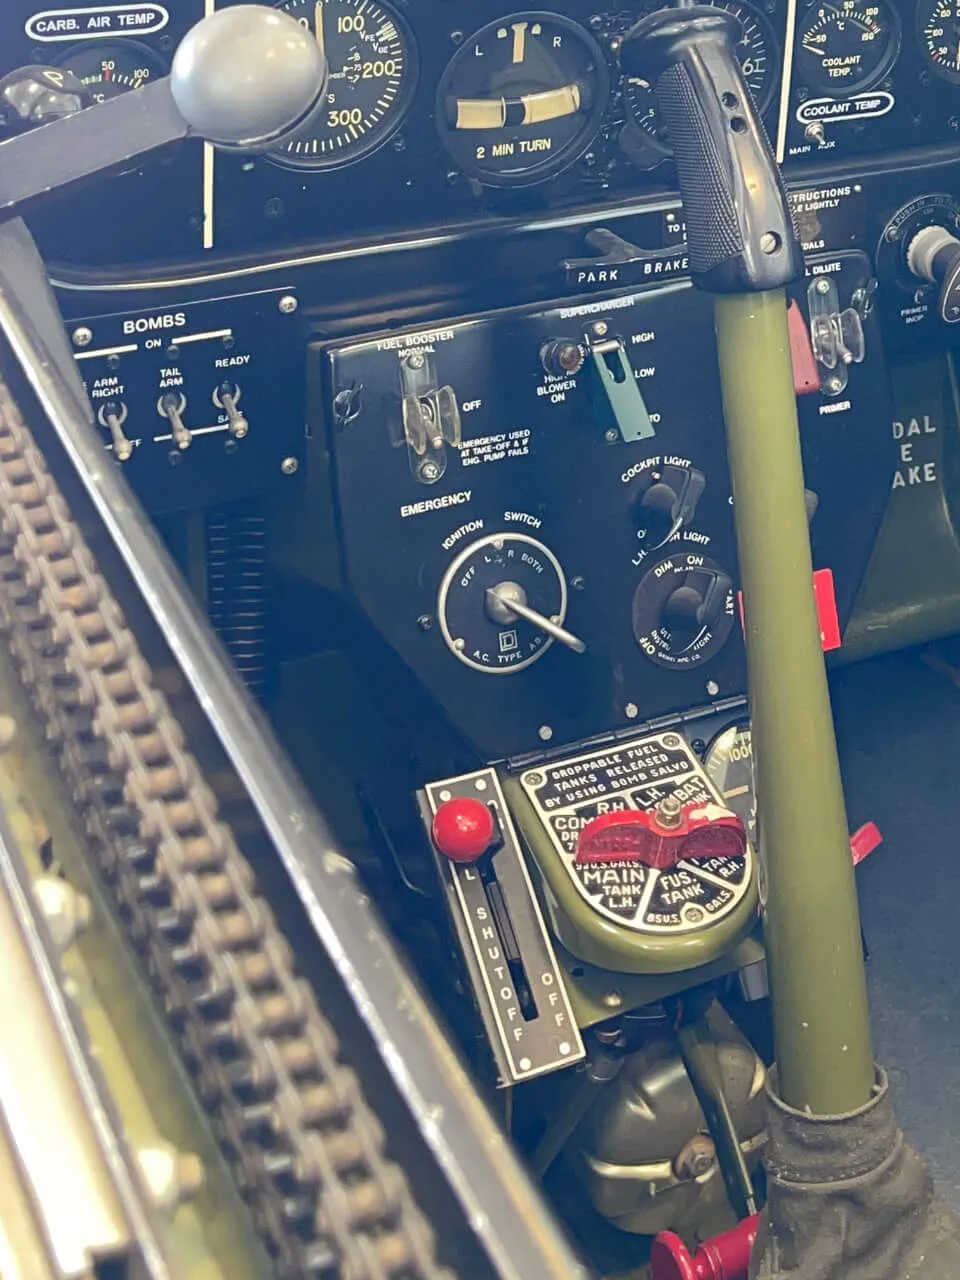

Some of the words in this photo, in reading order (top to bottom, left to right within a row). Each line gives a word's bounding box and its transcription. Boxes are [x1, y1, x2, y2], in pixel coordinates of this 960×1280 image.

[36, 21, 80, 32] CARB.
[87, 16, 111, 27] AIR
[117, 13, 155, 25] TEMP
[338, 16, 364, 33] 100
[362, 60, 396, 79] 200
[822, 56, 860, 67] COOLANT
[804, 103, 849, 117] COOLANT
[855, 100, 881, 111] TEMP
[327, 108, 362, 127] 300
[477, 147, 485, 158] 2
[493, 143, 515, 156] MIN
[519, 139, 551, 151] TURN
[805, 199, 840, 212] LIGHTLY
[578, 270, 618, 282] PARK
[644, 258, 689, 274] BRAKE
[560, 297, 634, 319] SUPERCHARGER
[123, 313, 185, 334] BOMBS
[145, 339, 161, 349] ON
[406, 330, 454, 346] BOOSTER
[632, 332, 654, 344] HIGH
[215, 355, 250, 368] READY
[160, 367, 181, 377] TAIL
[634, 367, 655, 378] LOW
[94, 377, 118, 388] ARM
[160, 377, 183, 388] ARM
[537, 380, 576, 396] BLOWER
[92, 386, 124, 398] RIGHT
[463, 401, 482, 412] OFF
[820, 402, 851, 415] PRIMER
[458, 434, 506, 450] EMERGENCY
[509, 429, 530, 440] USED
[461, 450, 470, 458] AT
[473, 441, 511, 455] TAKE-OFF
[462, 457, 481, 466] ENG.
[484, 452, 505, 462] PUMP
[508, 446, 528, 457] FAILS
[621, 456, 660, 482] COCKPIT
[664, 456, 691, 468] LIGHT
[401, 491, 471, 516] EMERGENCY
[442, 520, 484, 550] IGNITION
[504, 511, 541, 529] SWITCH
[683, 531, 710, 545] LIGHT
[497, 651, 522, 663] TYPE
[552, 756, 621, 780] DROPPABLE
[627, 745, 658, 759] FUEL
[555, 774, 597, 791] TANKS
[607, 754, 669, 778] RELEASED
[546, 795, 561, 808] BY
[567, 783, 605, 802] USING
[611, 771, 647, 790] BOMB
[651, 760, 689, 777] SALVO
[584, 870, 645, 884] MAIN
[602, 885, 641, 894] TANK
[661, 884, 704, 905] TANK
